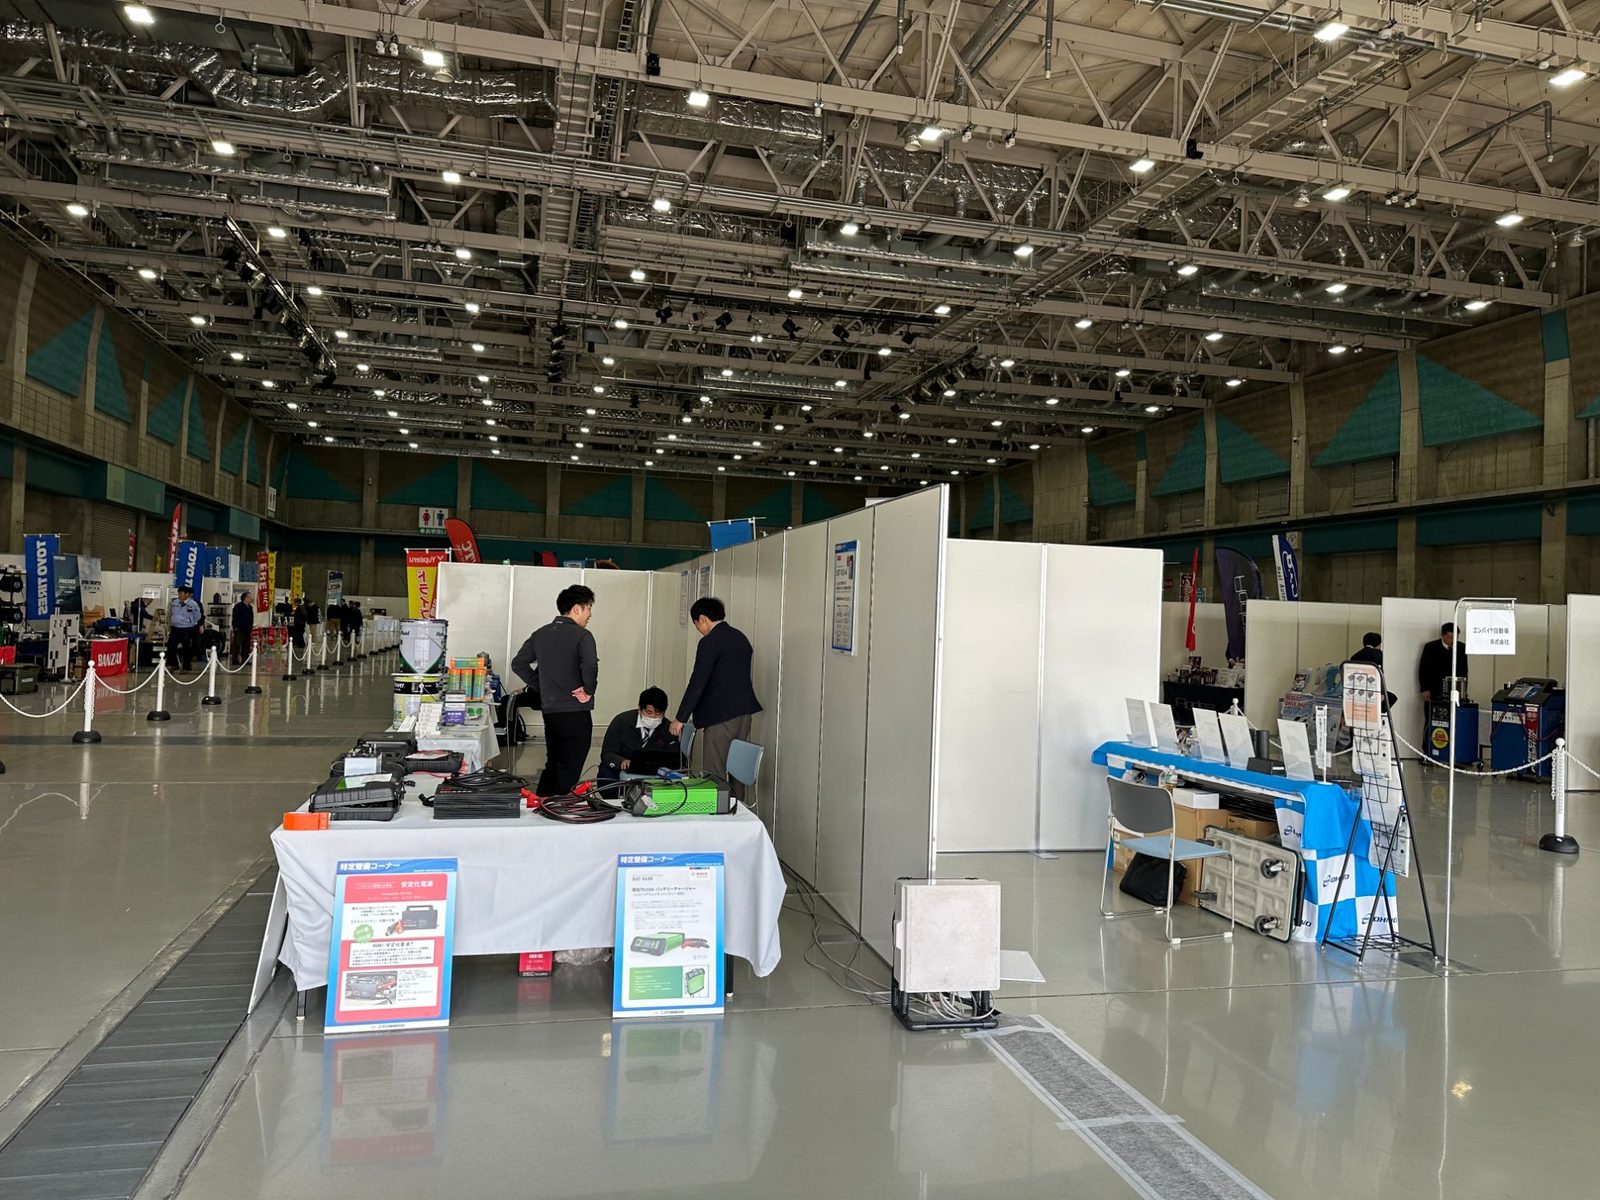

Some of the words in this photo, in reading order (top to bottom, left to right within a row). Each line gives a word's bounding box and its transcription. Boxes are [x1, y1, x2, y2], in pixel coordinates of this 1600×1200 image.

[186, 546, 198, 578] TOYO
[98, 651, 122, 667] BANZAI
[620, 855, 674, 865] 特定整備コーナー
[340, 862, 400, 872] 特定整備コーナー
